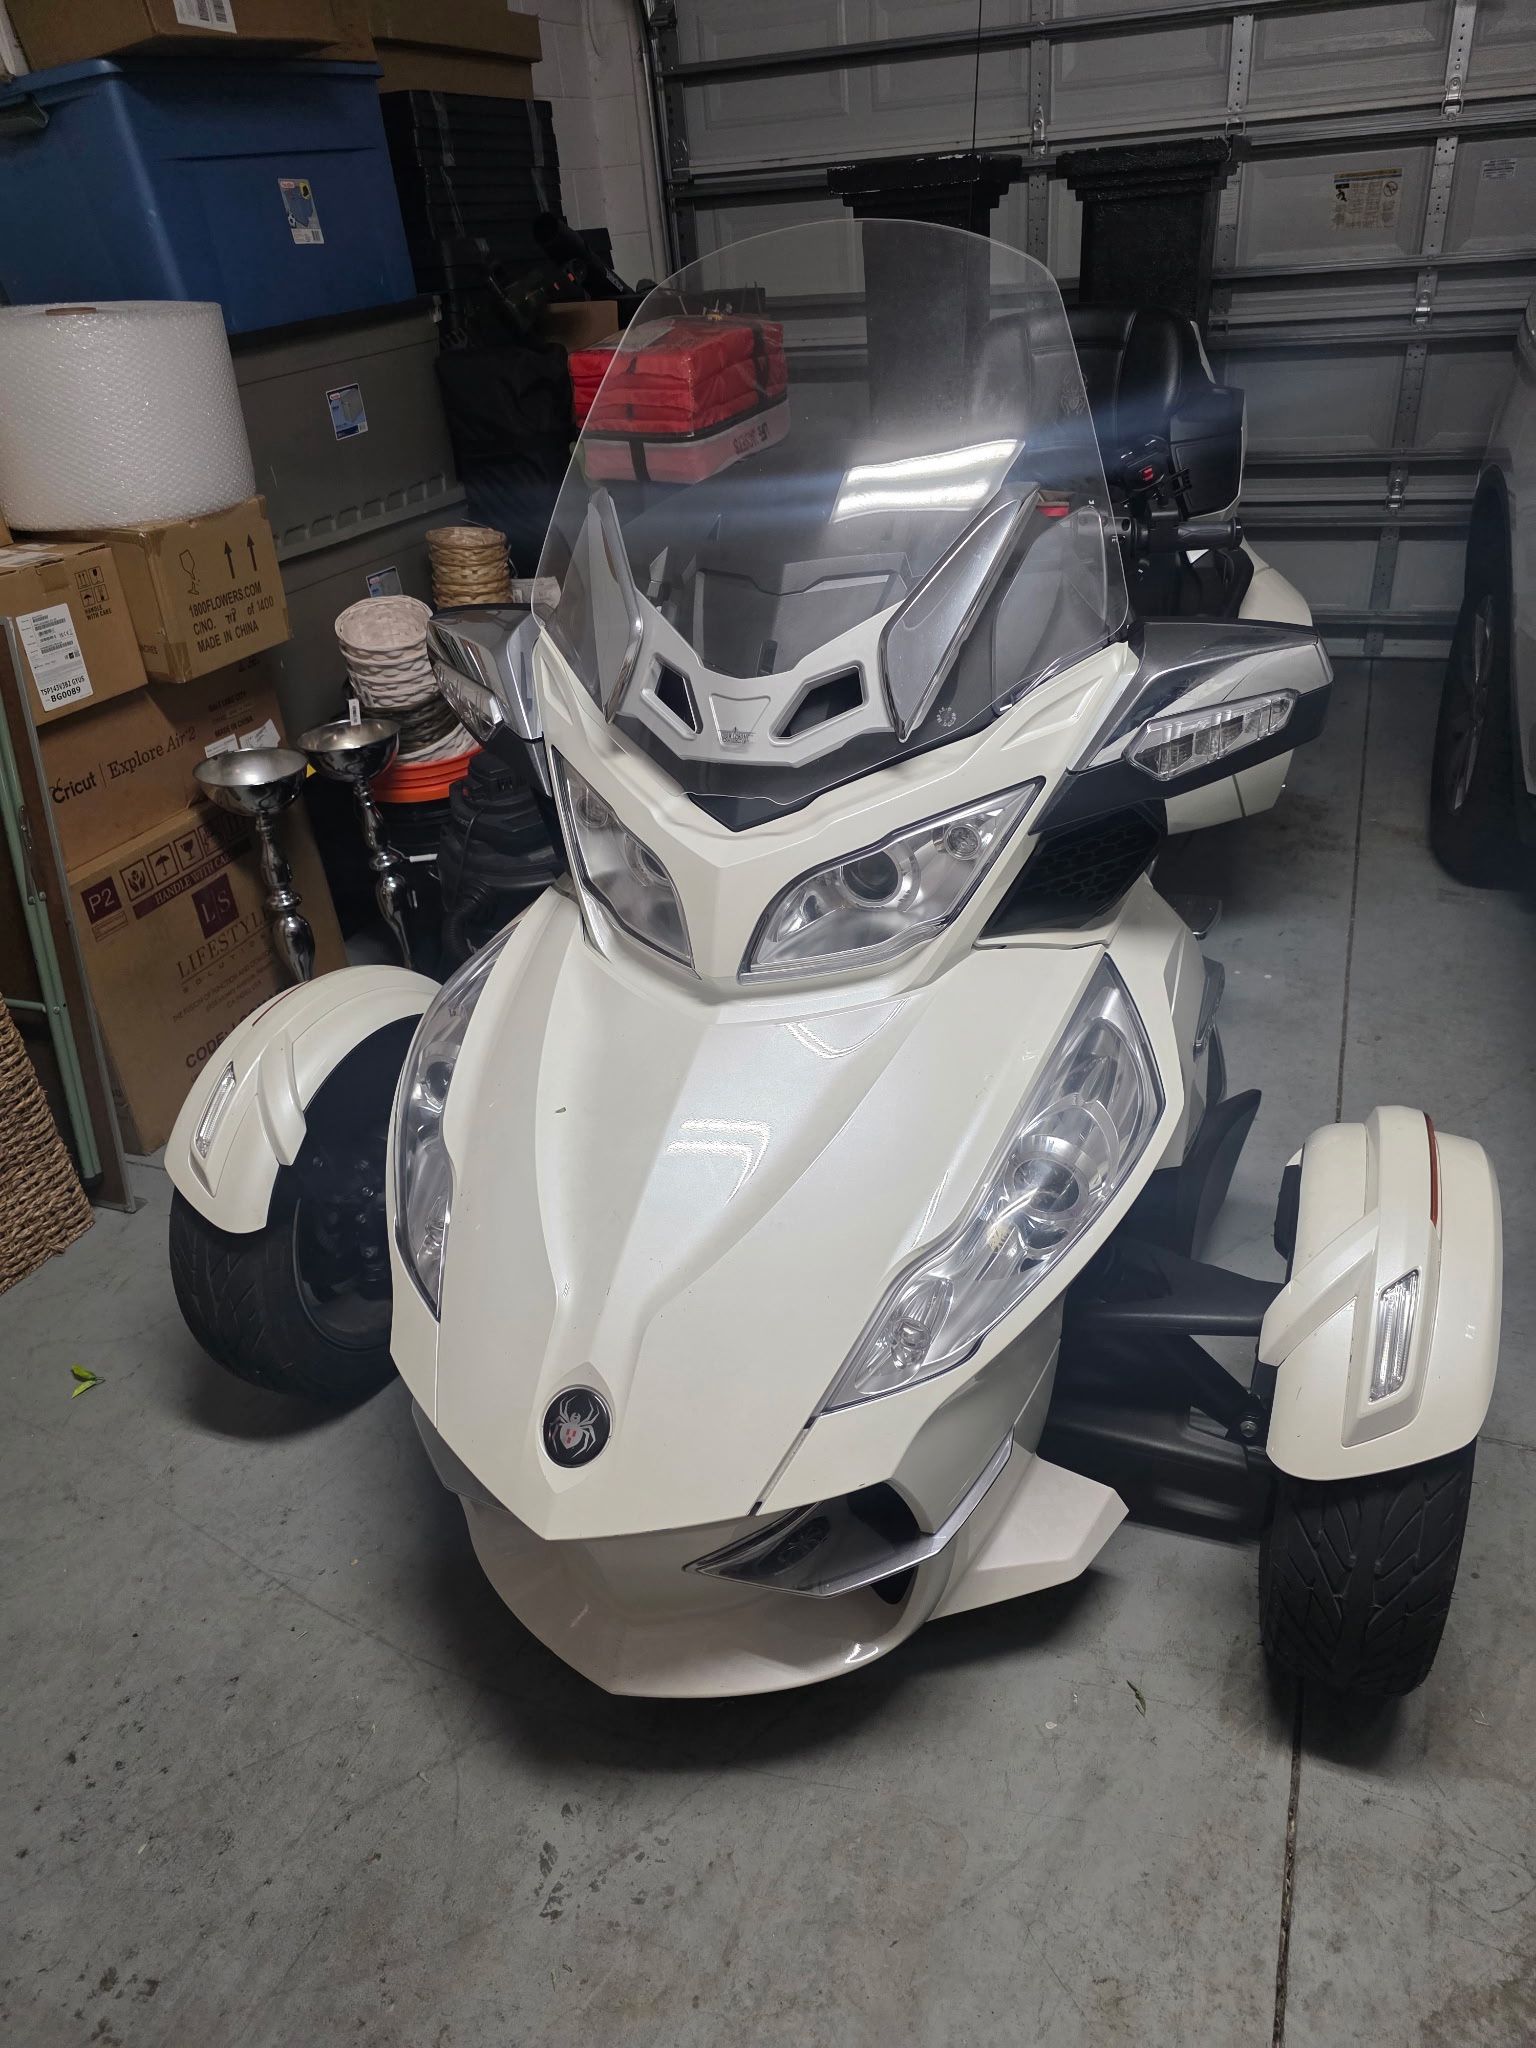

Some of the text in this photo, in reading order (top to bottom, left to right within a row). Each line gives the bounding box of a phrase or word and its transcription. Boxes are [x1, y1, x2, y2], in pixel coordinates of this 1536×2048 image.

[189, 580, 262, 618] 1800FLOWERS.COM
[247, 602, 255, 616] of
[257, 595, 275, 613] 1400
[197, 620, 259, 653] MADE IN CHINA
[51, 772, 97, 804] Cricut
[107, 745, 165, 780] Explore
[166, 732, 188, 753] Air
[155, 875, 192, 904] HANDLE
[190, 861, 216, 882] WITH
[88, 887, 116, 915] P2
